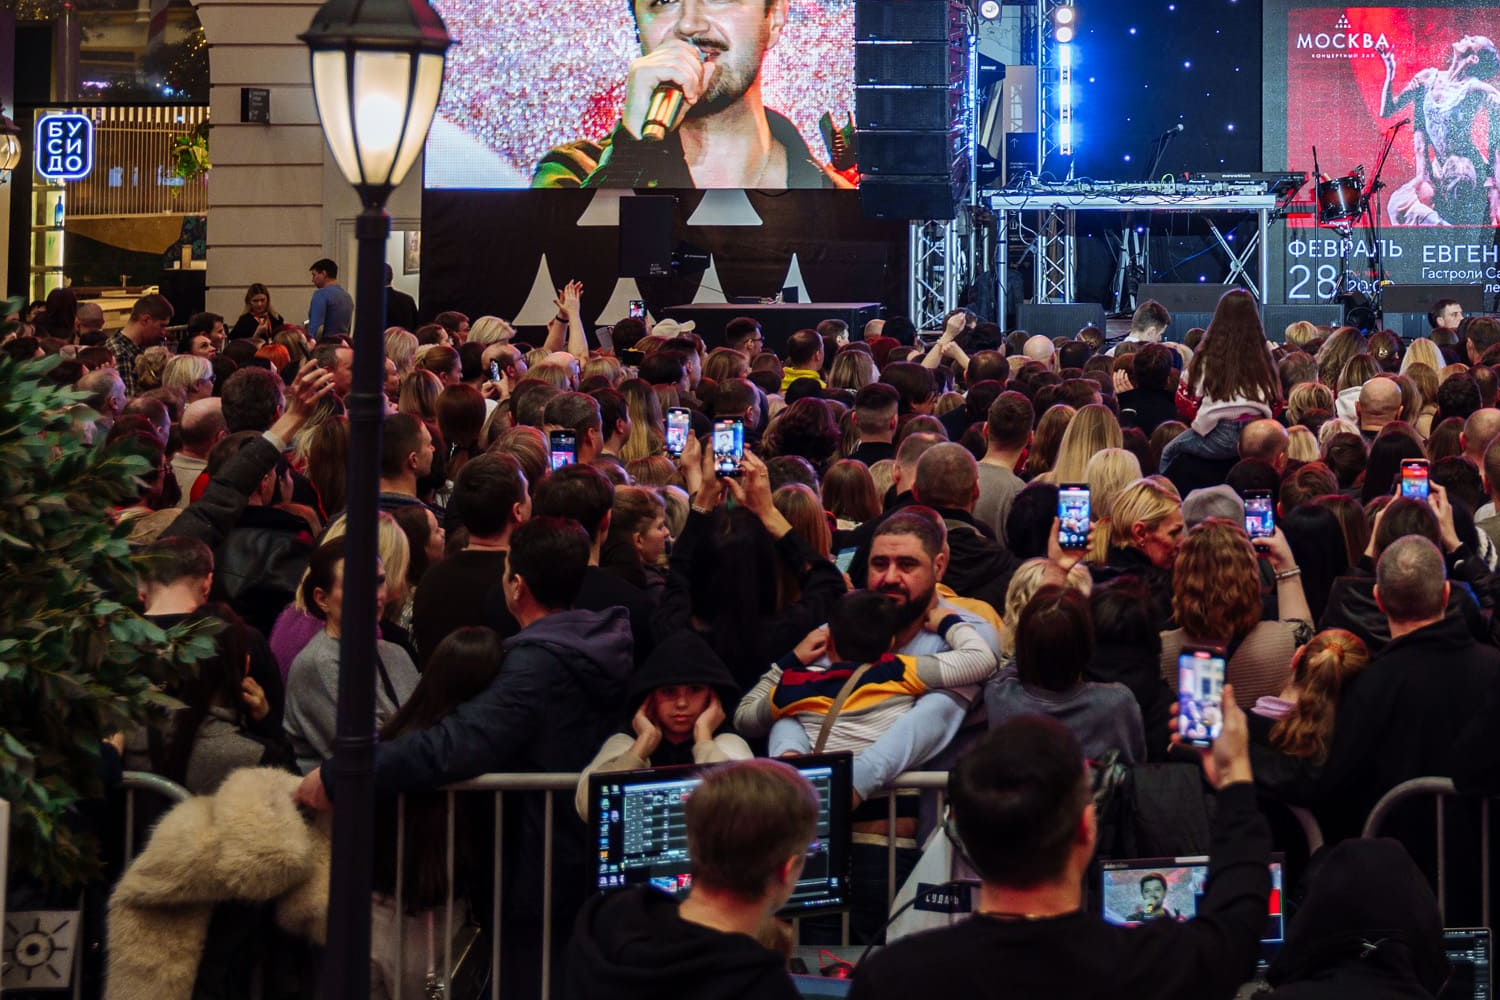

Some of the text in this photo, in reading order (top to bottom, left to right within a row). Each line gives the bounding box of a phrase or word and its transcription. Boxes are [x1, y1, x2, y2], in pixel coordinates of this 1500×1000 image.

[1296, 32, 1390, 49] МОСКВА
[1288, 239, 1403, 258] ФЕВРАЛЬ
[1288, 264, 1337, 299] 28
[1422, 267, 1483, 280] Гастроли
